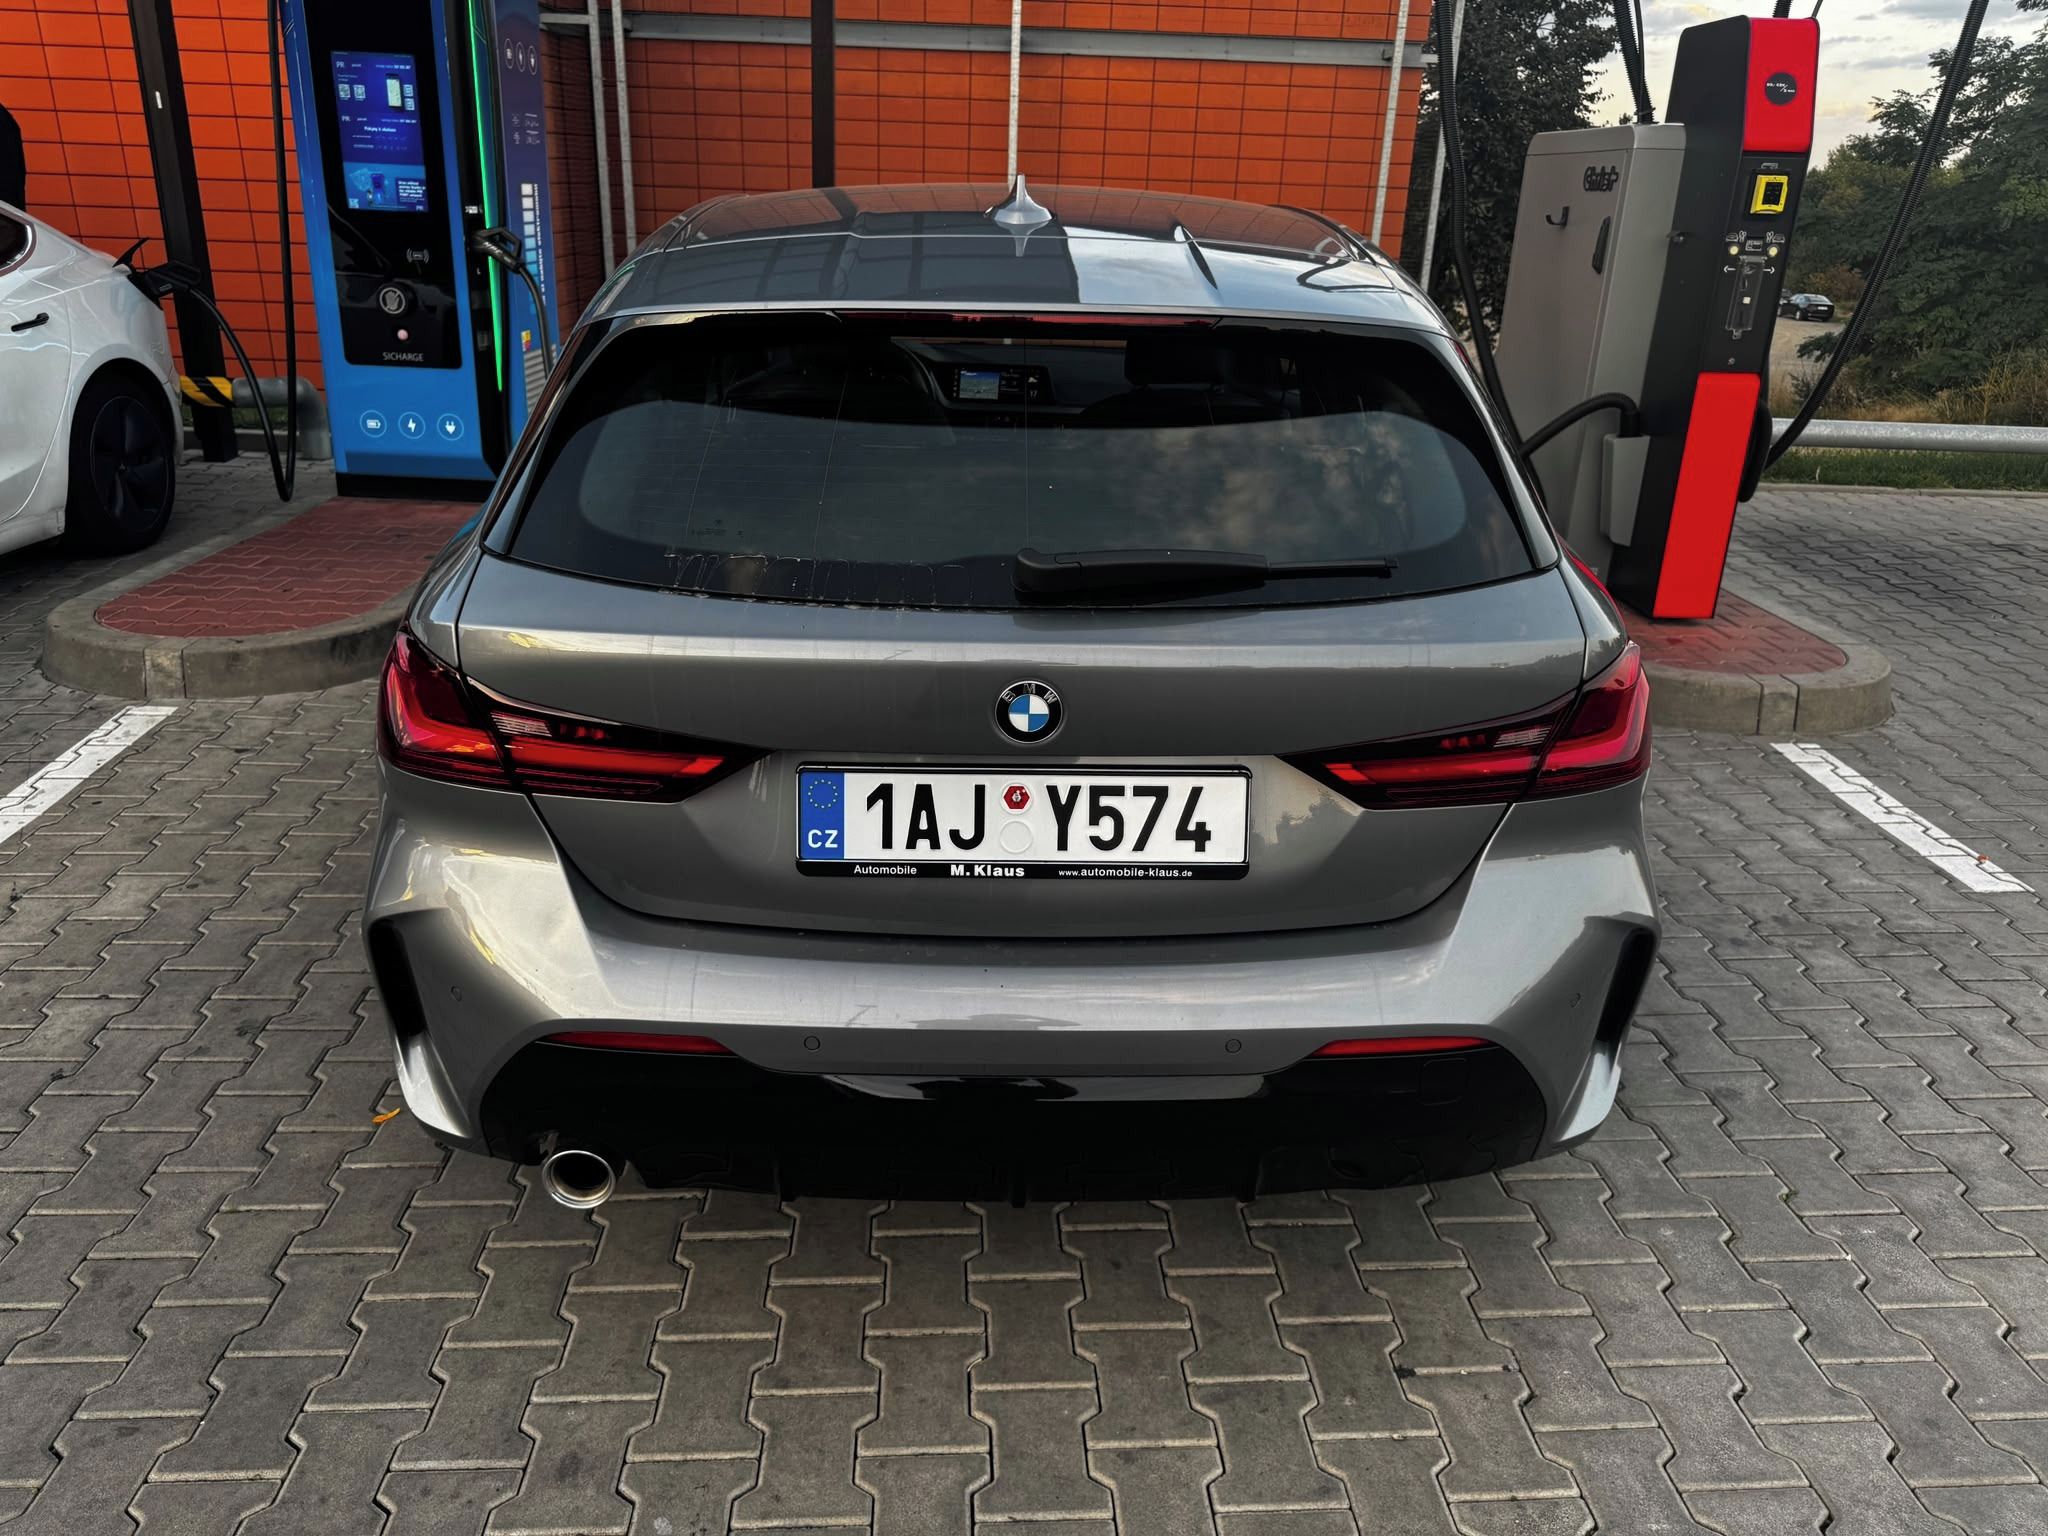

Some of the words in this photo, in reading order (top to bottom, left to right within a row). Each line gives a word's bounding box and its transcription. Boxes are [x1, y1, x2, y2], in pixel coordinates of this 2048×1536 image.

[382, 351, 425, 362] SICHARGE
[1002, 683, 1058, 705] BMW
[867, 783, 986, 851] 1AJ
[1045, 784, 1212, 853] Y574
[807, 829, 839, 849] CZ
[853, 864, 918, 875] Automobile
[950, 864, 970, 877] M.
[973, 864, 1025, 877] Klaus
[1058, 867, 1193, 877] www.automobile-klaus.de
